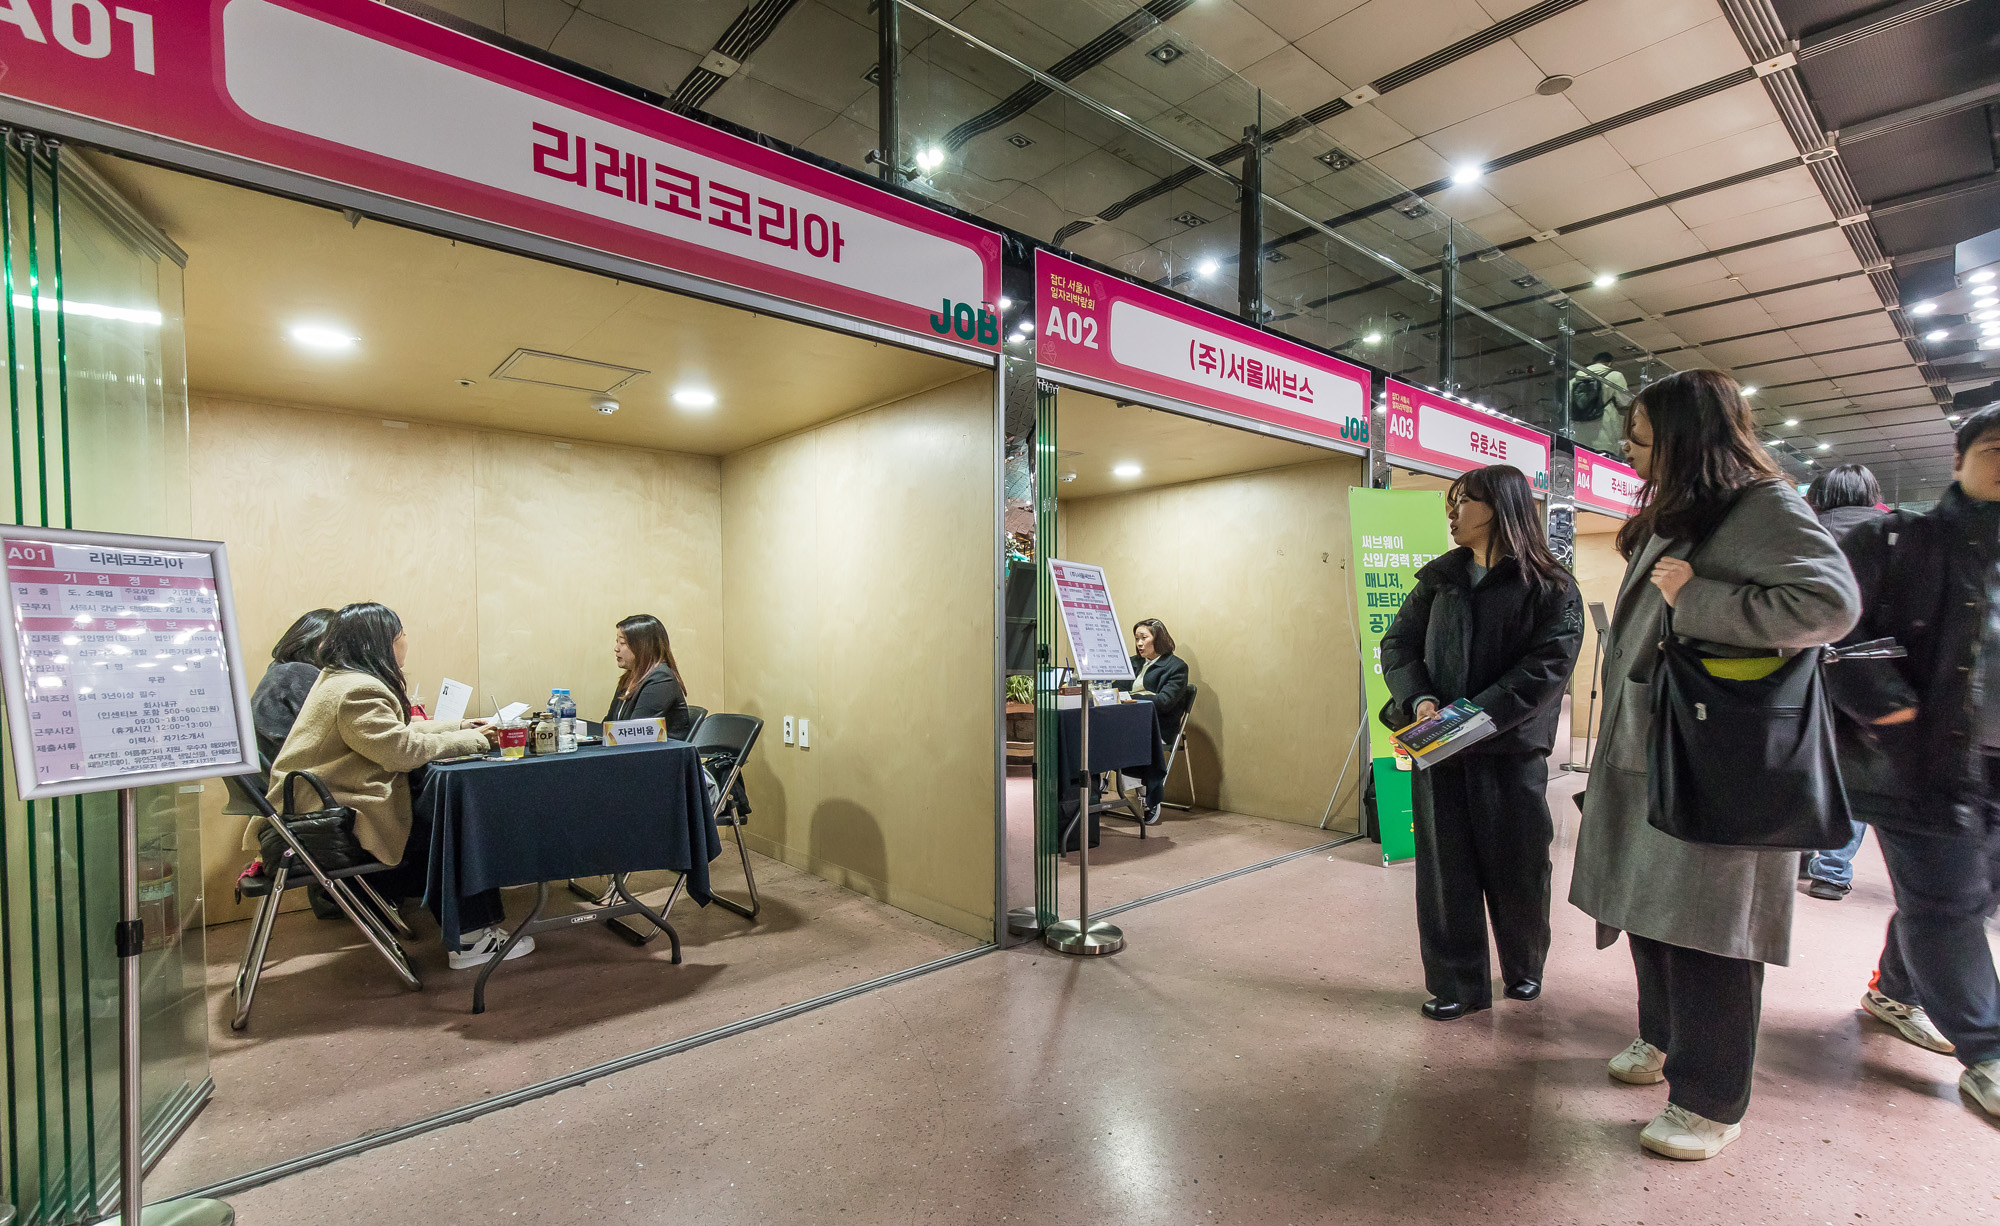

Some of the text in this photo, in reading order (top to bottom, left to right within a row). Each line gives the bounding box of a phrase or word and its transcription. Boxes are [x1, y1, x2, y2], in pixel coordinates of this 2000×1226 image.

[0, 0, 155, 75] A01
[532, 121, 845, 264] 리레코코리아
[1050, 273, 1091, 296] 잡다 서울시
[1050, 286, 1095, 311] 일자리박람회
[930, 298, 998, 346] JOB
[1045, 305, 1098, 350] A02
[1190, 339, 1314, 404] (주)서울써브스
[1340, 416, 1370, 443] JOB
[1389, 414, 1414, 440] A03
[1470, 431, 1507, 460] 유호스트
[1533, 471, 1549, 490] JOB
[1576, 472, 1590, 490] A04
[1362, 535, 1404, 550] 써브웨이
[8, 547, 46, 560] A01
[89, 552, 184, 570] 리레코코리아
[1362, 553, 1410, 568] 신입/경력
[64, 573, 170, 586] 기 업 정 보
[1364, 572, 1403, 590] 매니저,
[20, 602, 51, 611] 근무지
[1366, 592, 1408, 608] 파트타
[166, 621, 177, 630] 보
[148, 676, 166, 684] 무관
[190, 688, 206, 696] 신입
[144, 700, 178, 708] 회사내규
[32, 710, 72, 720] 급 여
[98, 710, 138, 719] (인센티브
[142, 708, 160, 716] 포함
[34, 726, 74, 736] 근무시간
[112, 725, 151, 734] (휴게시간
[164, 732, 205, 742] 자기소개서
[618, 725, 655, 738] 자리비움
[36, 742, 77, 752] 제출서류
[40, 766, 49, 774] 기
